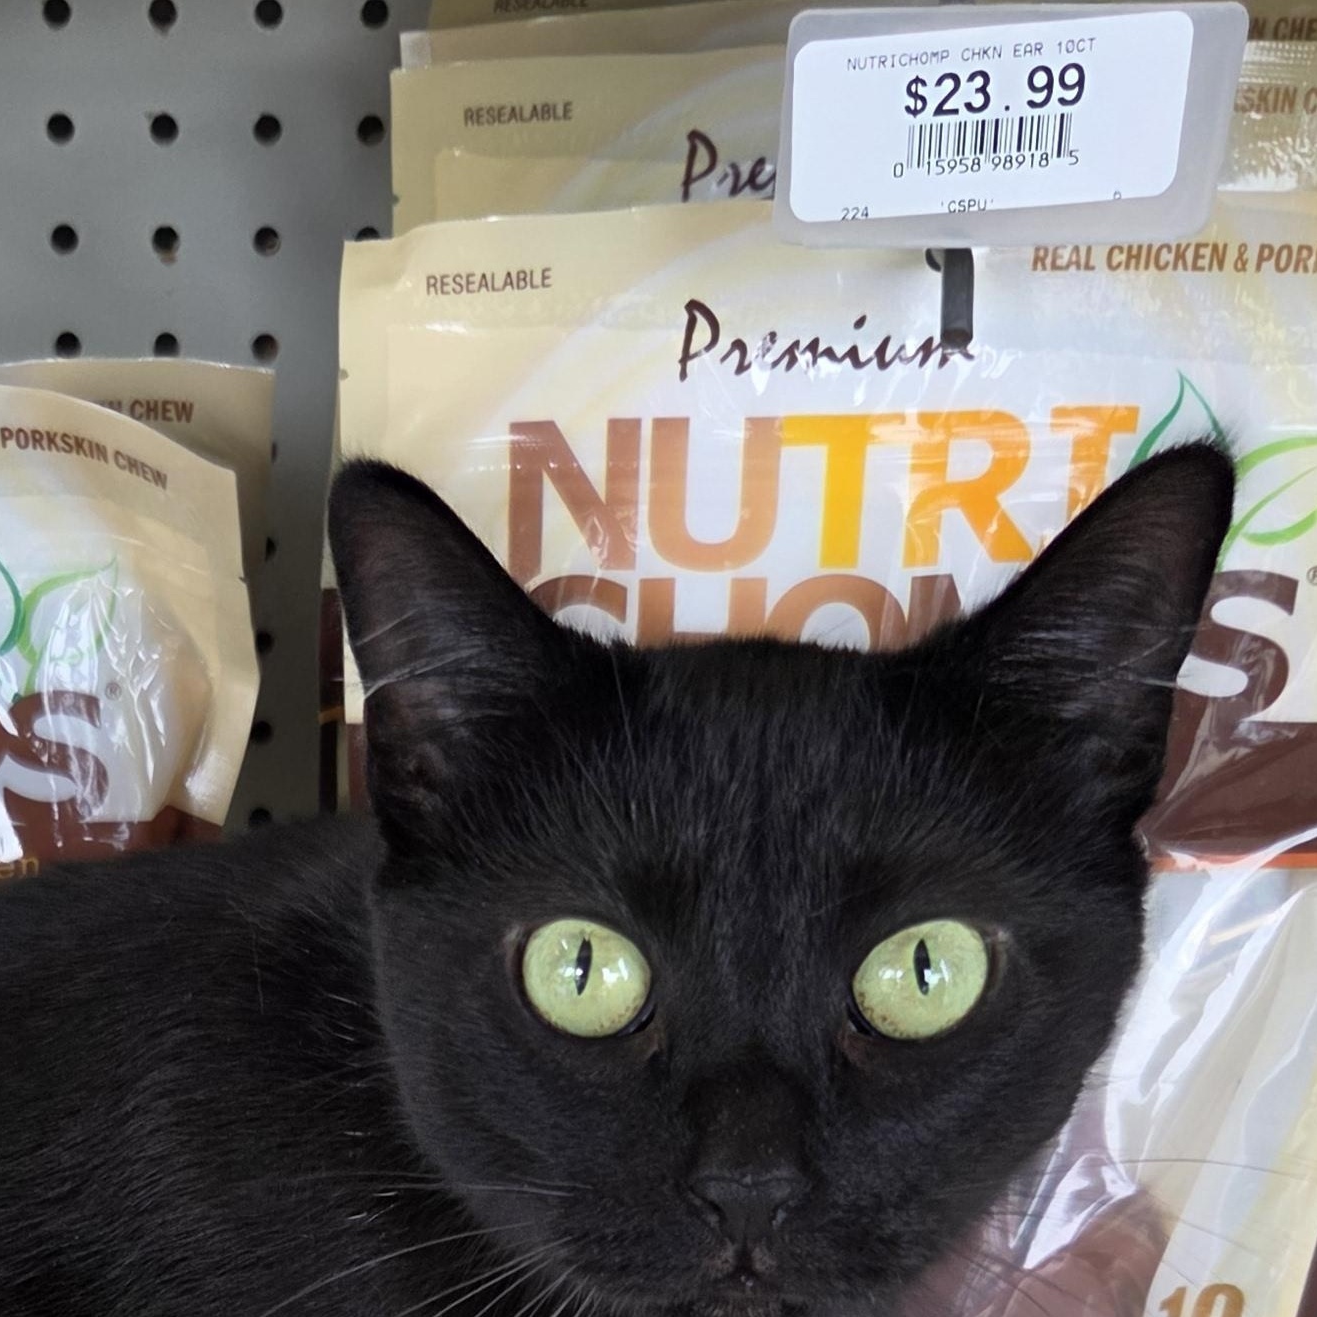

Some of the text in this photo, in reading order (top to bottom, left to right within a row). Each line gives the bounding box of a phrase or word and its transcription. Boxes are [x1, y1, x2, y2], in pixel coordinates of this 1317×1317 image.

[847, 37, 1097, 71] NUTRICHOMP CHKN EAR 10CT
[904, 62, 1087, 118] $23.99
[464, 102, 573, 128] RESEALABLE
[893, 149, 1080, 179] 0 15958 98918 5
[1032, 242, 1317, 273] REAL CHICKEN & POR
[426, 267, 553, 296] RESEALABLE
[130, 399, 194, 423] CHEW
[1, 427, 109, 465] PORKSKIN
[114, 450, 168, 491] CHEW
